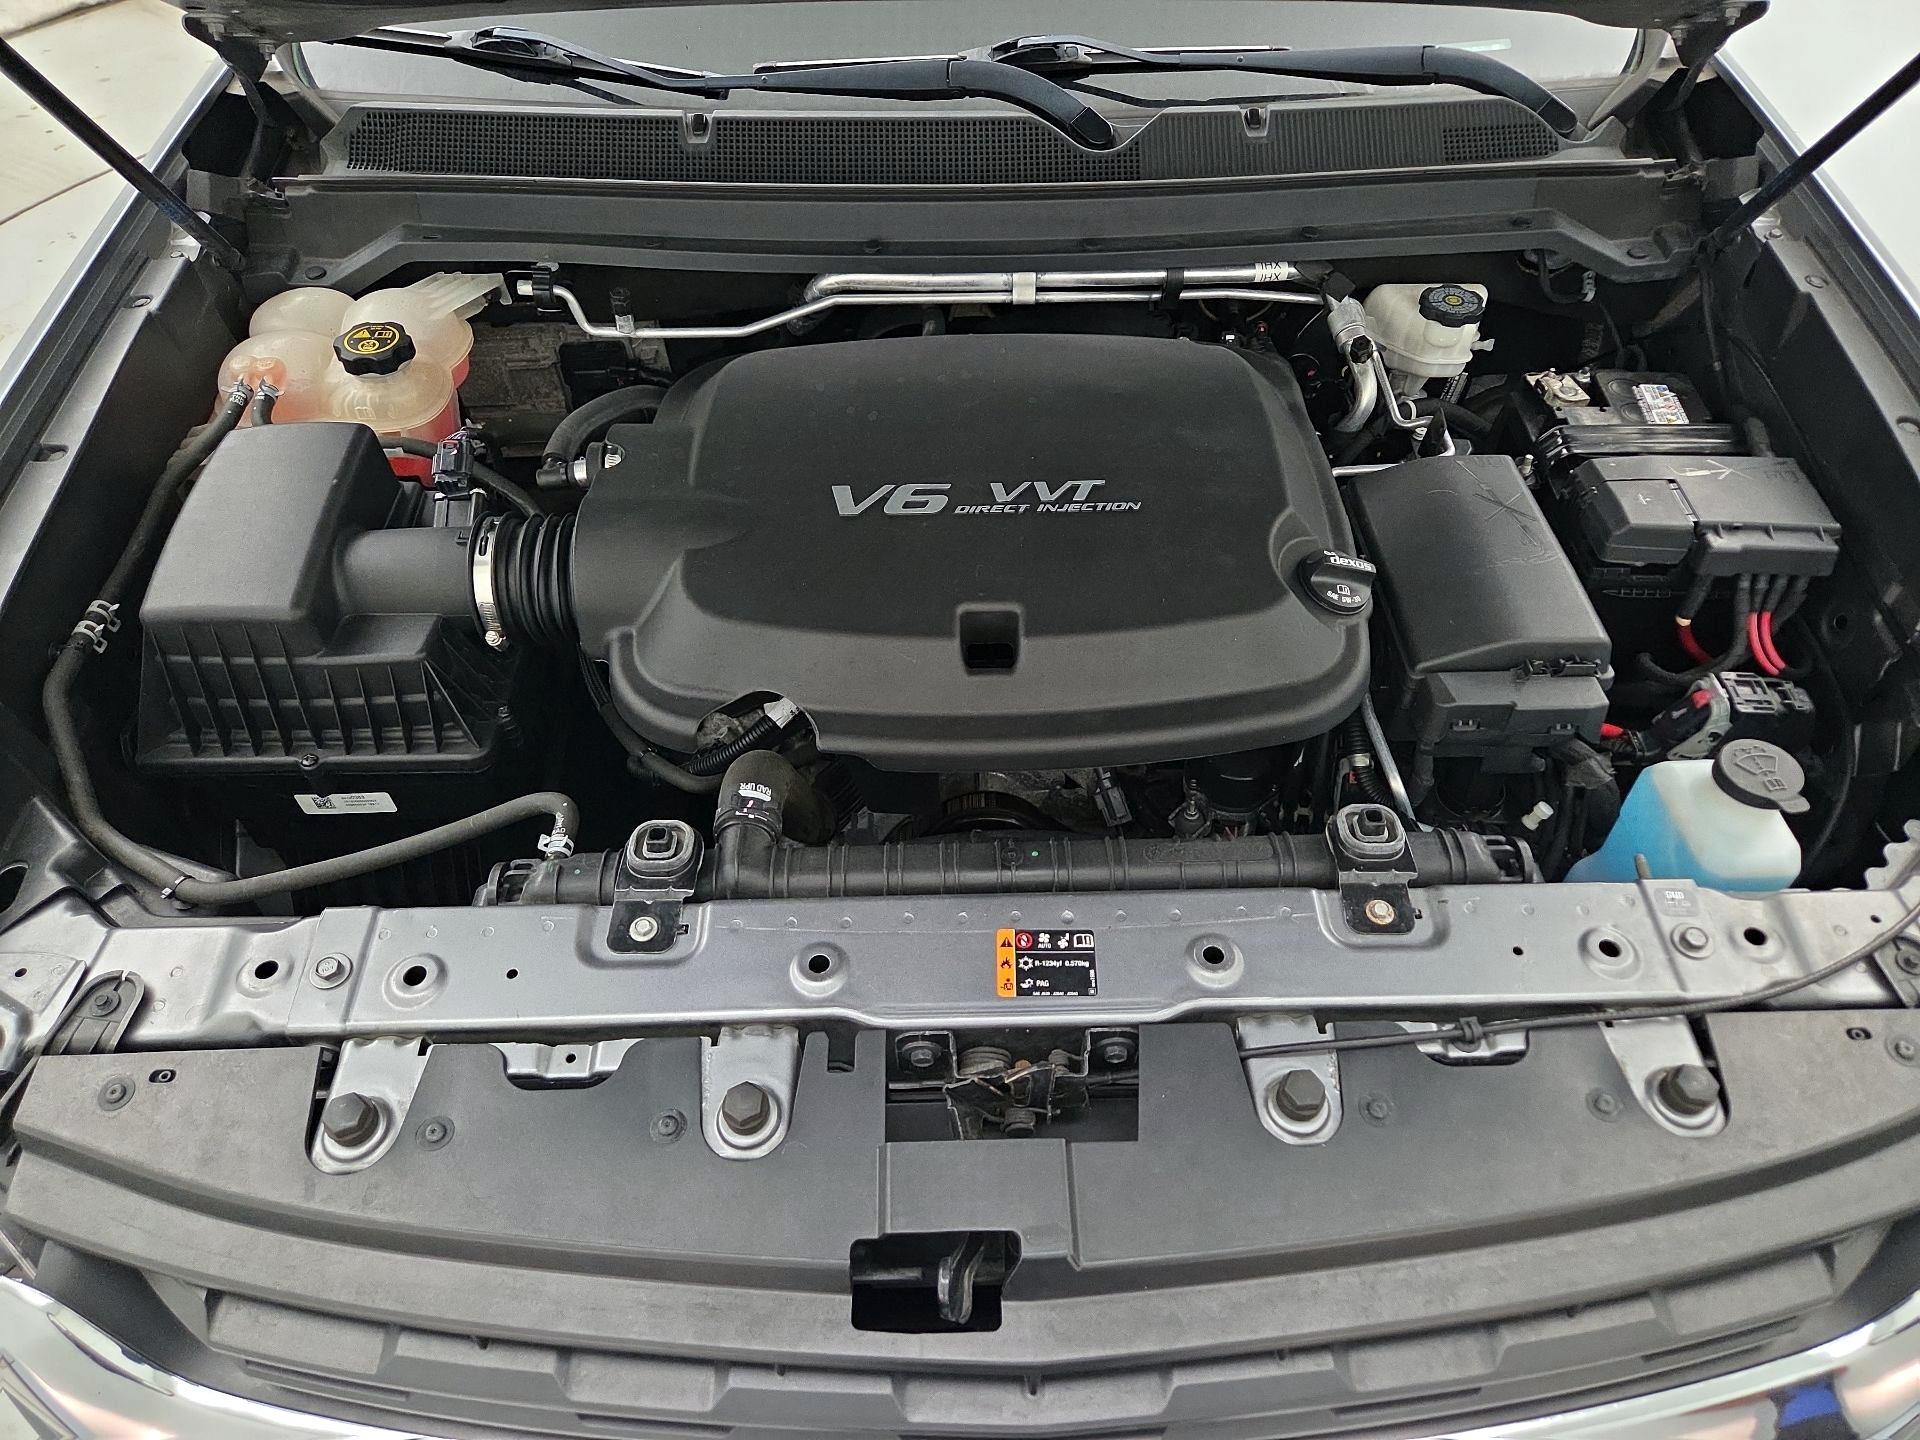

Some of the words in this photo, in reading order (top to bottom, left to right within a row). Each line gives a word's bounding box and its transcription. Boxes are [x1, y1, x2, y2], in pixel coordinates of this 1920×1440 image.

[990, 480, 1106, 501] VVT
[832, 484, 951, 516] V6
[955, 502, 1031, 514] DIRECT
[1036, 501, 1142, 513] INJECTION
[1328, 553, 1372, 571] dexos
[1326, 590, 1340, 601] SAE
[739, 782, 756, 791] UPR
[756, 784, 772, 797] RAD
